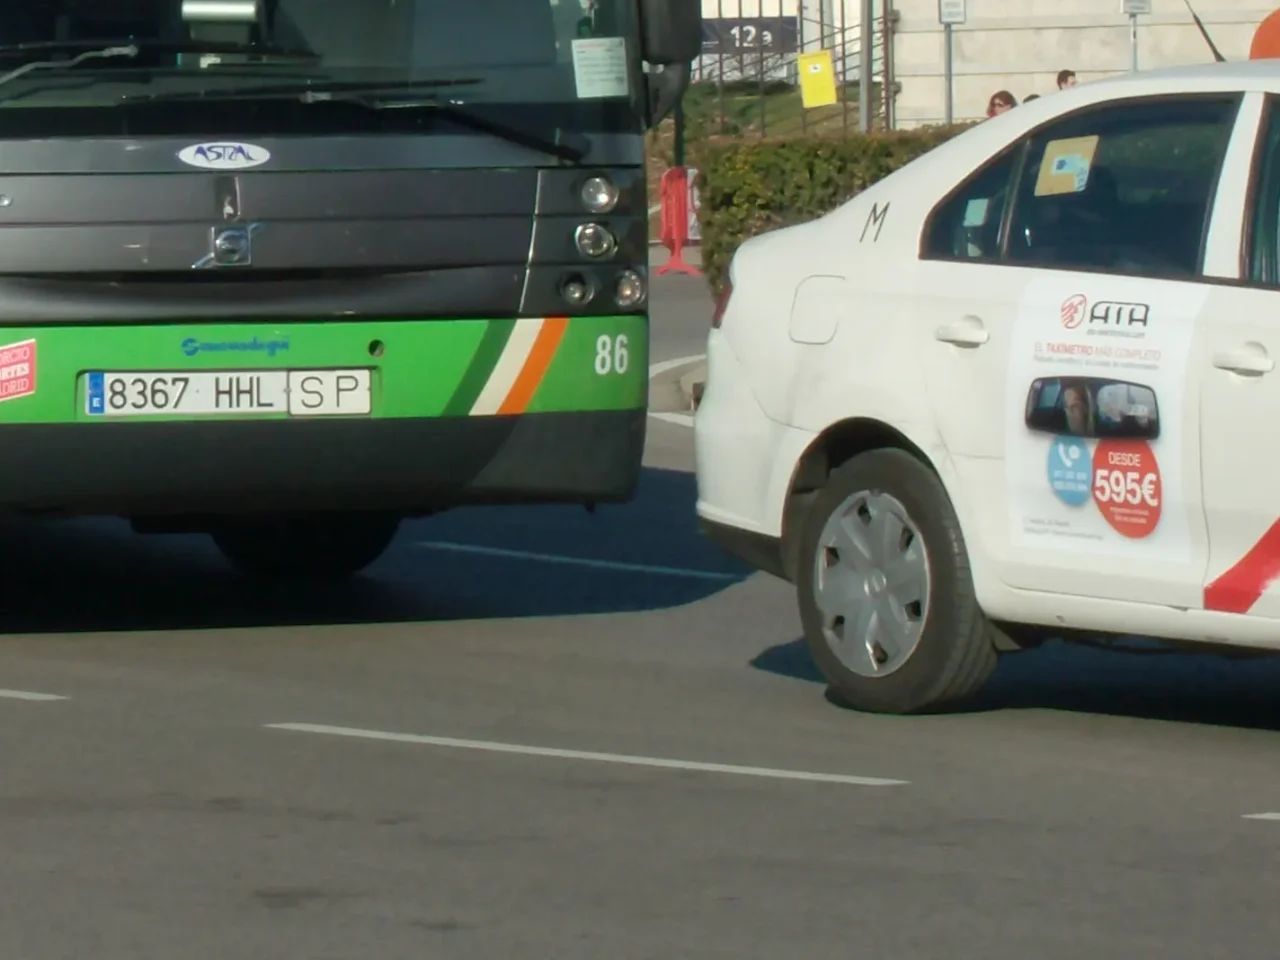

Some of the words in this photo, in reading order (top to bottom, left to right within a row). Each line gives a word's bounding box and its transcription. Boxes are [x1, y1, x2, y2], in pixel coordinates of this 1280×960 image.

[729, 24, 756, 47] 12
[193, 144, 258, 162] ASTRAL
[859, 201, 891, 243] M
[594, 334, 629, 375] 86
[108, 377, 190, 410] 8367
[214, 375, 275, 409] HHL
[1108, 451, 1141, 467] DESDE
[1094, 468, 1159, 507] 595€
